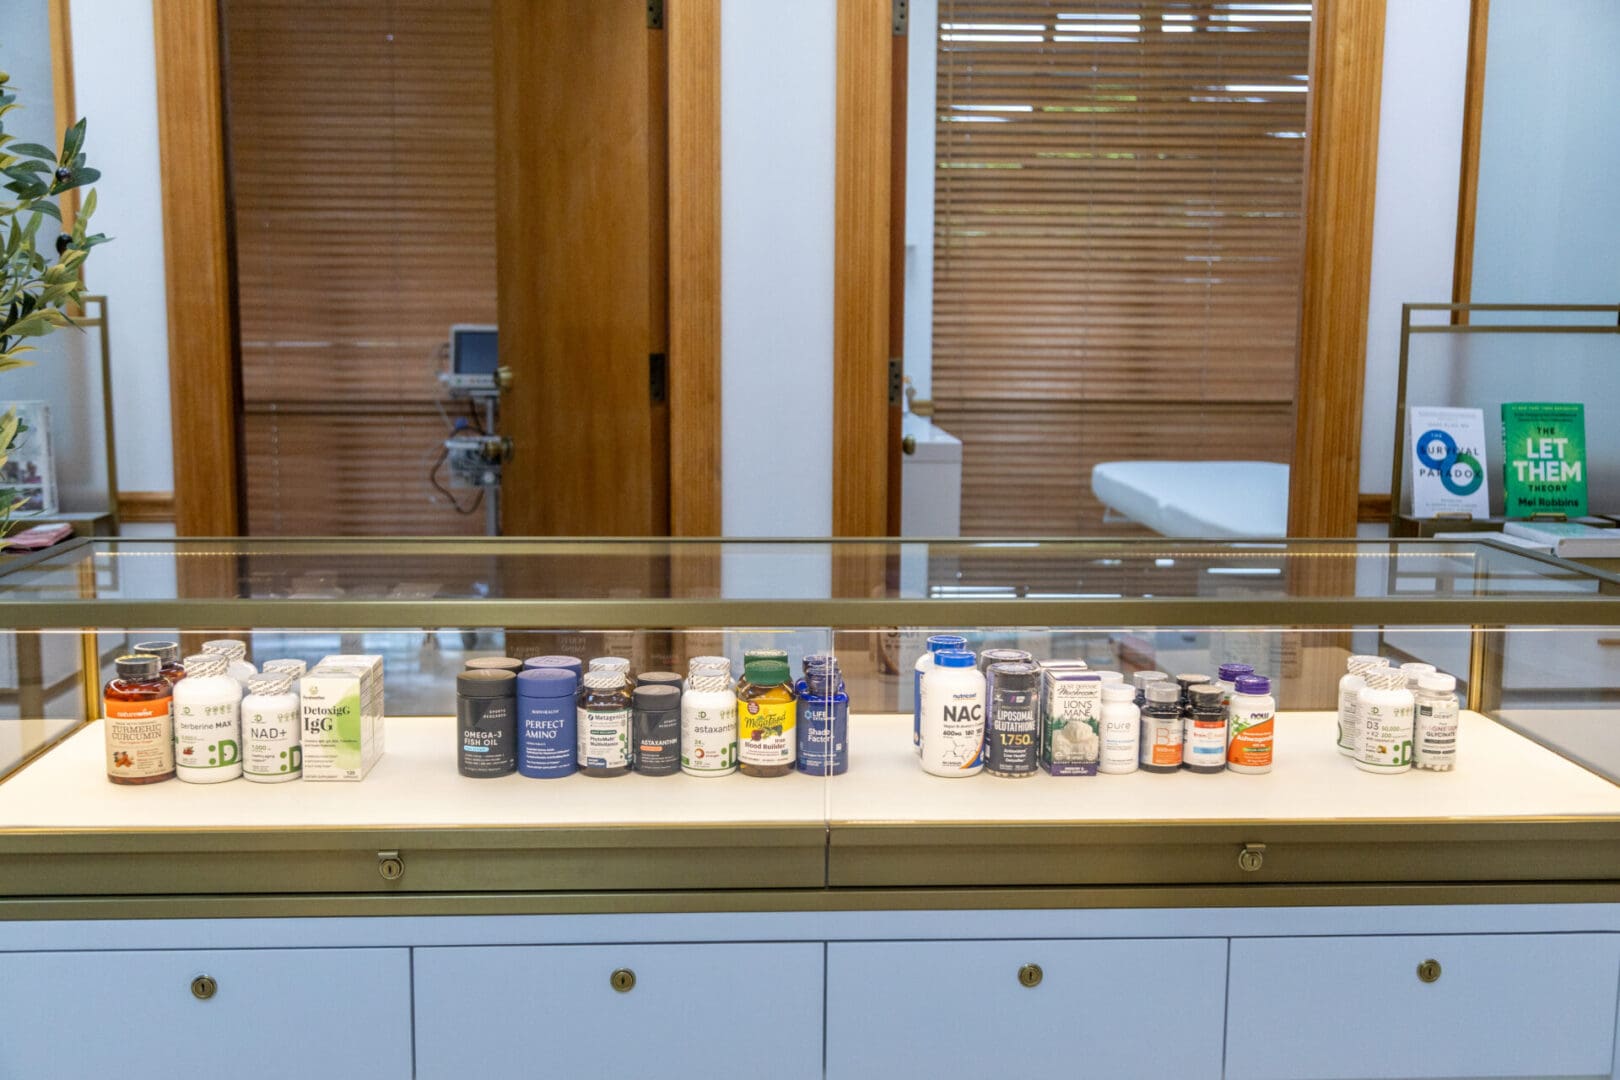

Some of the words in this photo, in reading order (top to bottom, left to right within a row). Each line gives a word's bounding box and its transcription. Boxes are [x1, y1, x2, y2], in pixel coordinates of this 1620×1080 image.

[1537, 427, 1555, 435] THE
[1527, 438, 1568, 458] LET
[1420, 468, 1481, 478] PARADOX
[1513, 461, 1581, 482] THEM
[1518, 498, 1536, 506] Mel
[1539, 498, 1579, 507] Robbins
[1064, 700, 1092, 708] LION'S
[944, 704, 981, 722] NAC
[997, 710, 1033, 721] LIPOSOMAL
[112, 724, 161, 733] TURMERIC
[216, 720, 232, 728] MAX
[304, 718, 333, 734] IgG
[526, 720, 564, 729] PERFECT
[1367, 721, 1379, 730] D3
[112, 732, 161, 740] CURCUMIN
[251, 728, 287, 739] NAD+
[464, 730, 502, 739] OMEGA-3
[526, 730, 557, 739] AMINO
[464, 738, 481, 746] FISH
